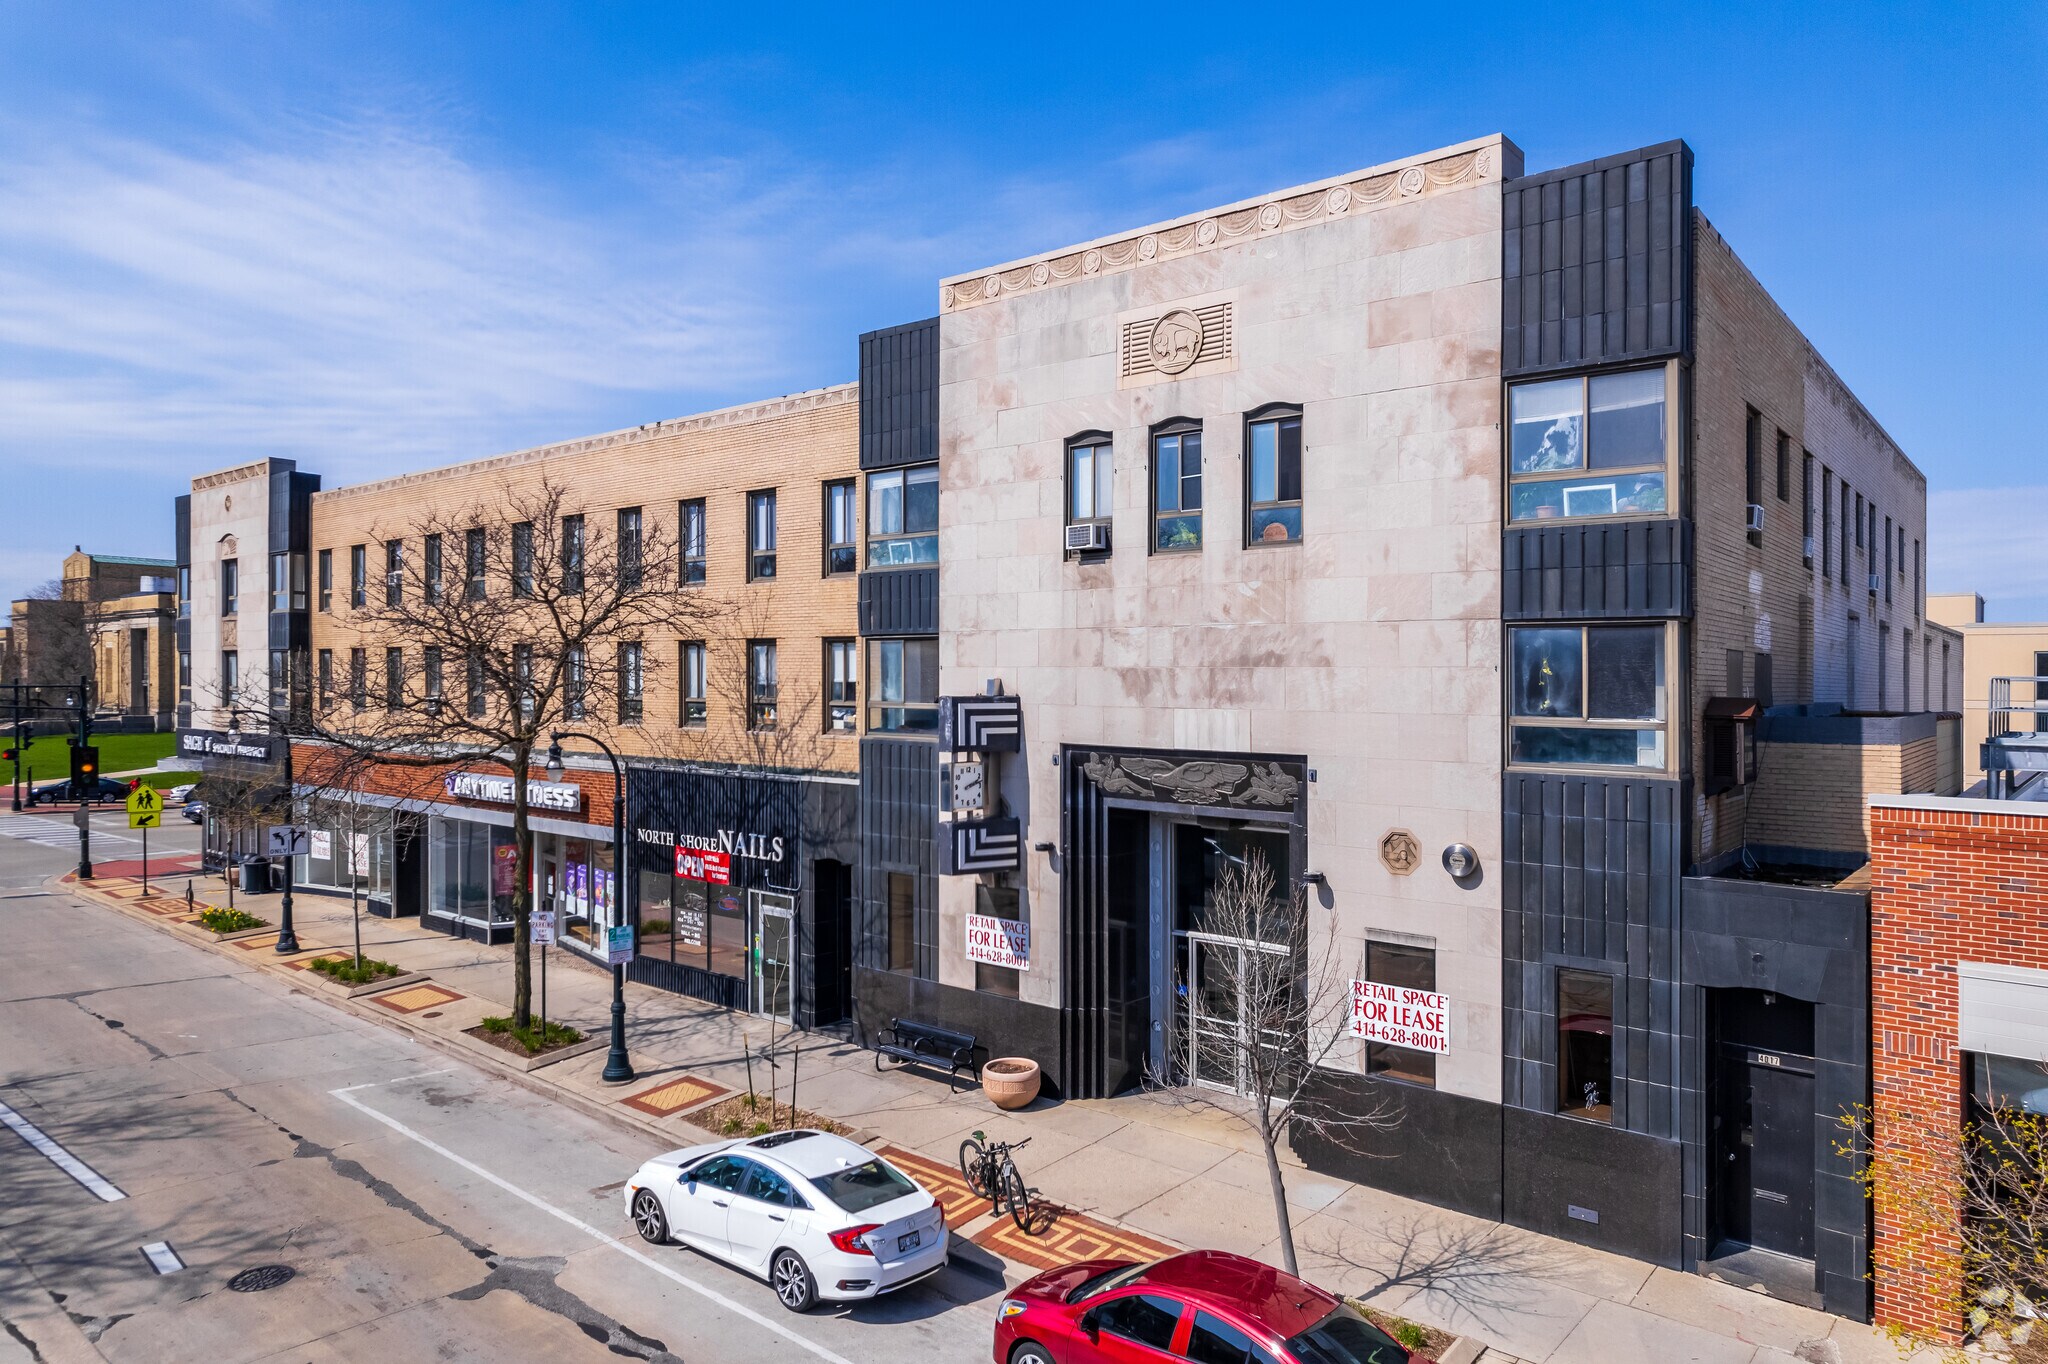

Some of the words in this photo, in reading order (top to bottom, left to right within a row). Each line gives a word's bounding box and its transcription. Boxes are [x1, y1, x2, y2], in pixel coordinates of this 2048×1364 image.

[183, 734, 203, 751] SAGE
[454, 776, 512, 800] ANYTIME
[512, 783, 575, 807] TNESS
[637, 828, 675, 846] NORTH
[680, 834, 718, 852] SHORE
[718, 829, 784, 862] NAILS
[677, 853, 705, 878] OPEN
[609, 930, 616, 940] 2
[969, 915, 997, 931] RETAIL
[1000, 920, 1027, 936] SPACE
[969, 929, 990, 947] FOR
[993, 933, 1026, 954] LEASE
[969, 946, 1027, 968] 414-628-8001
[1354, 981, 1398, 1003] RETAIL
[1402, 989, 1445, 1010] SPACE
[1354, 998, 1388, 1023] FOR
[1393, 1005, 1445, 1034] LEASE
[1353, 1020, 1445, 1051] 414-628-8001
[1759, 1055, 1779, 1065] 4017
